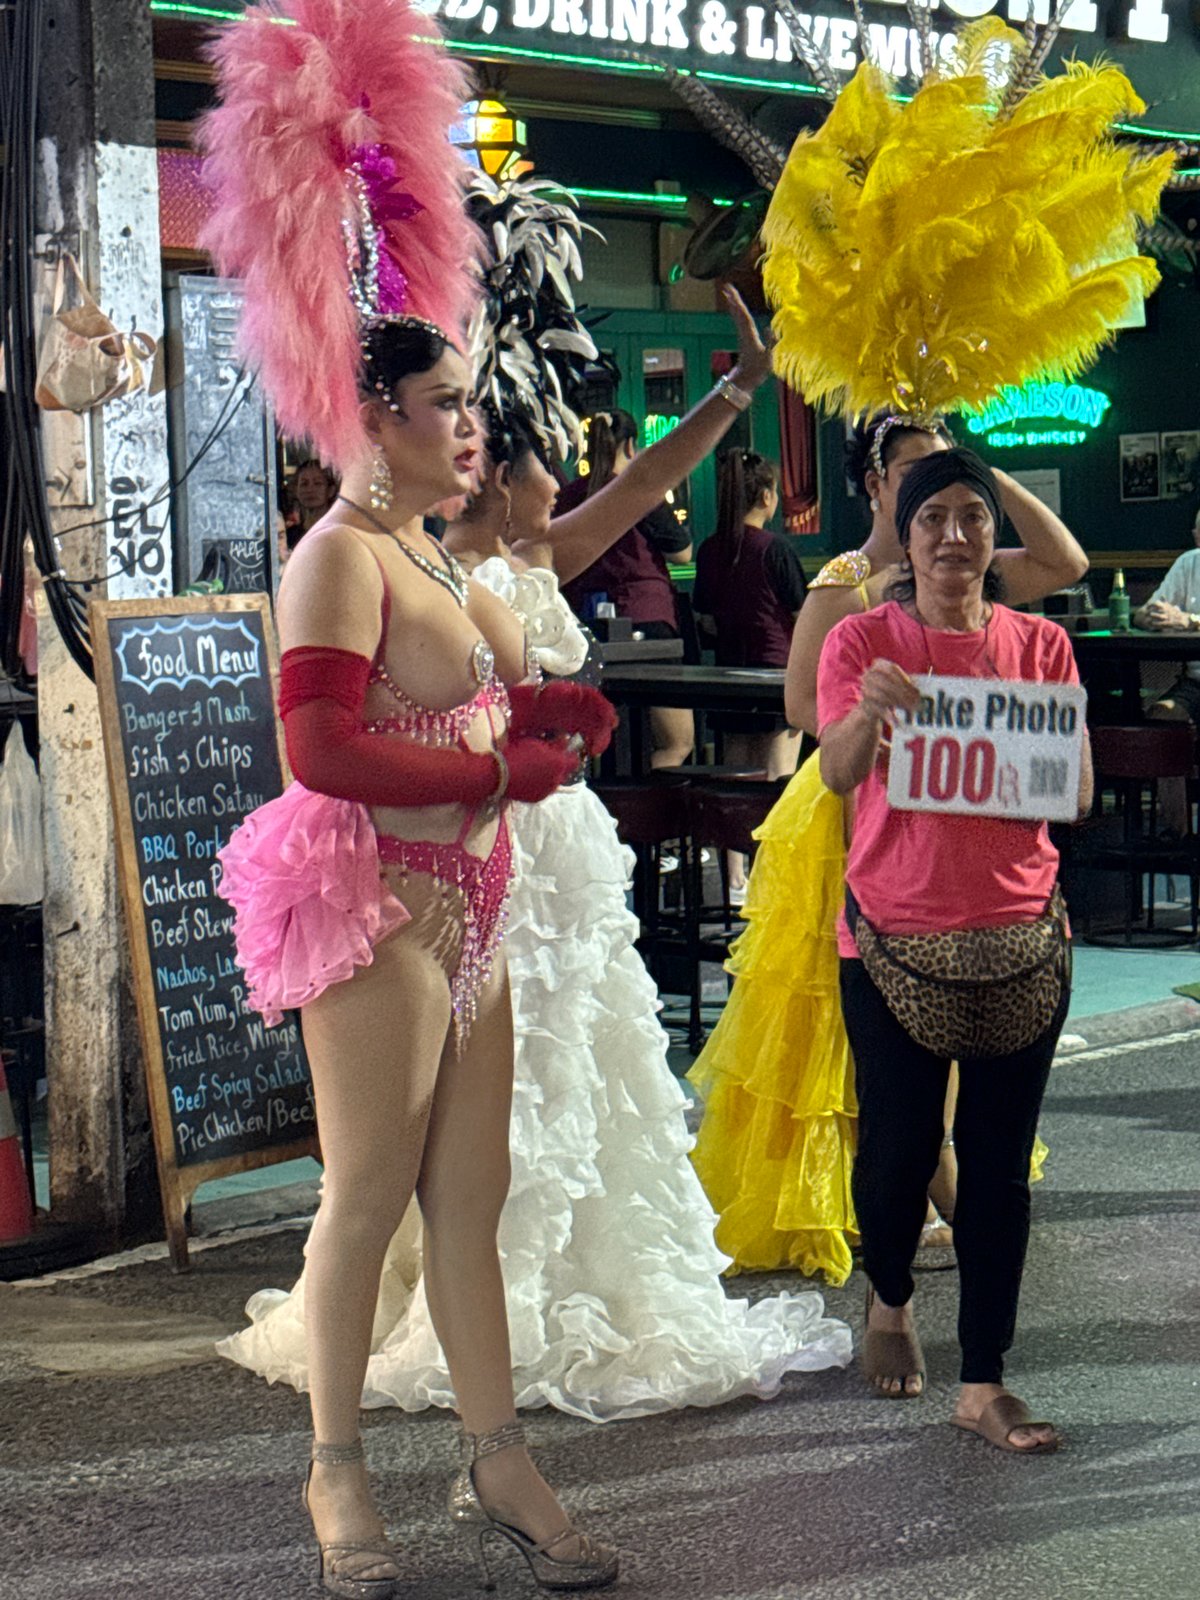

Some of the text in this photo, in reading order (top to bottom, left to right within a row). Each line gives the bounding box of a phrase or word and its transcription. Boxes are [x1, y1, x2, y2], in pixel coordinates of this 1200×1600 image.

[512, 0, 689, 49] DRINK
[699, 0, 737, 55] &
[746, 5, 858, 70] LIVE
[867, 23, 1011, 89] MUSC
[988, 431, 1086, 447] IRISH WHISKEY
[197, 634, 256, 674] Menu
[207, 690, 258, 725] Mash
[985, 692, 1077, 734] Photo
[196, 735, 252, 782] Chips
[134, 784, 207, 822] Chicken
[141, 833, 179, 863] BBQ
[143, 868, 207, 907] Chicken
[151, 905, 189, 948] Beef
[157, 953, 216, 992] Nachos,
[159, 1005, 194, 1031] Tom
[246, 1020, 297, 1060] Wings
[171, 1054, 309, 1113] Beef Spicy Salad
